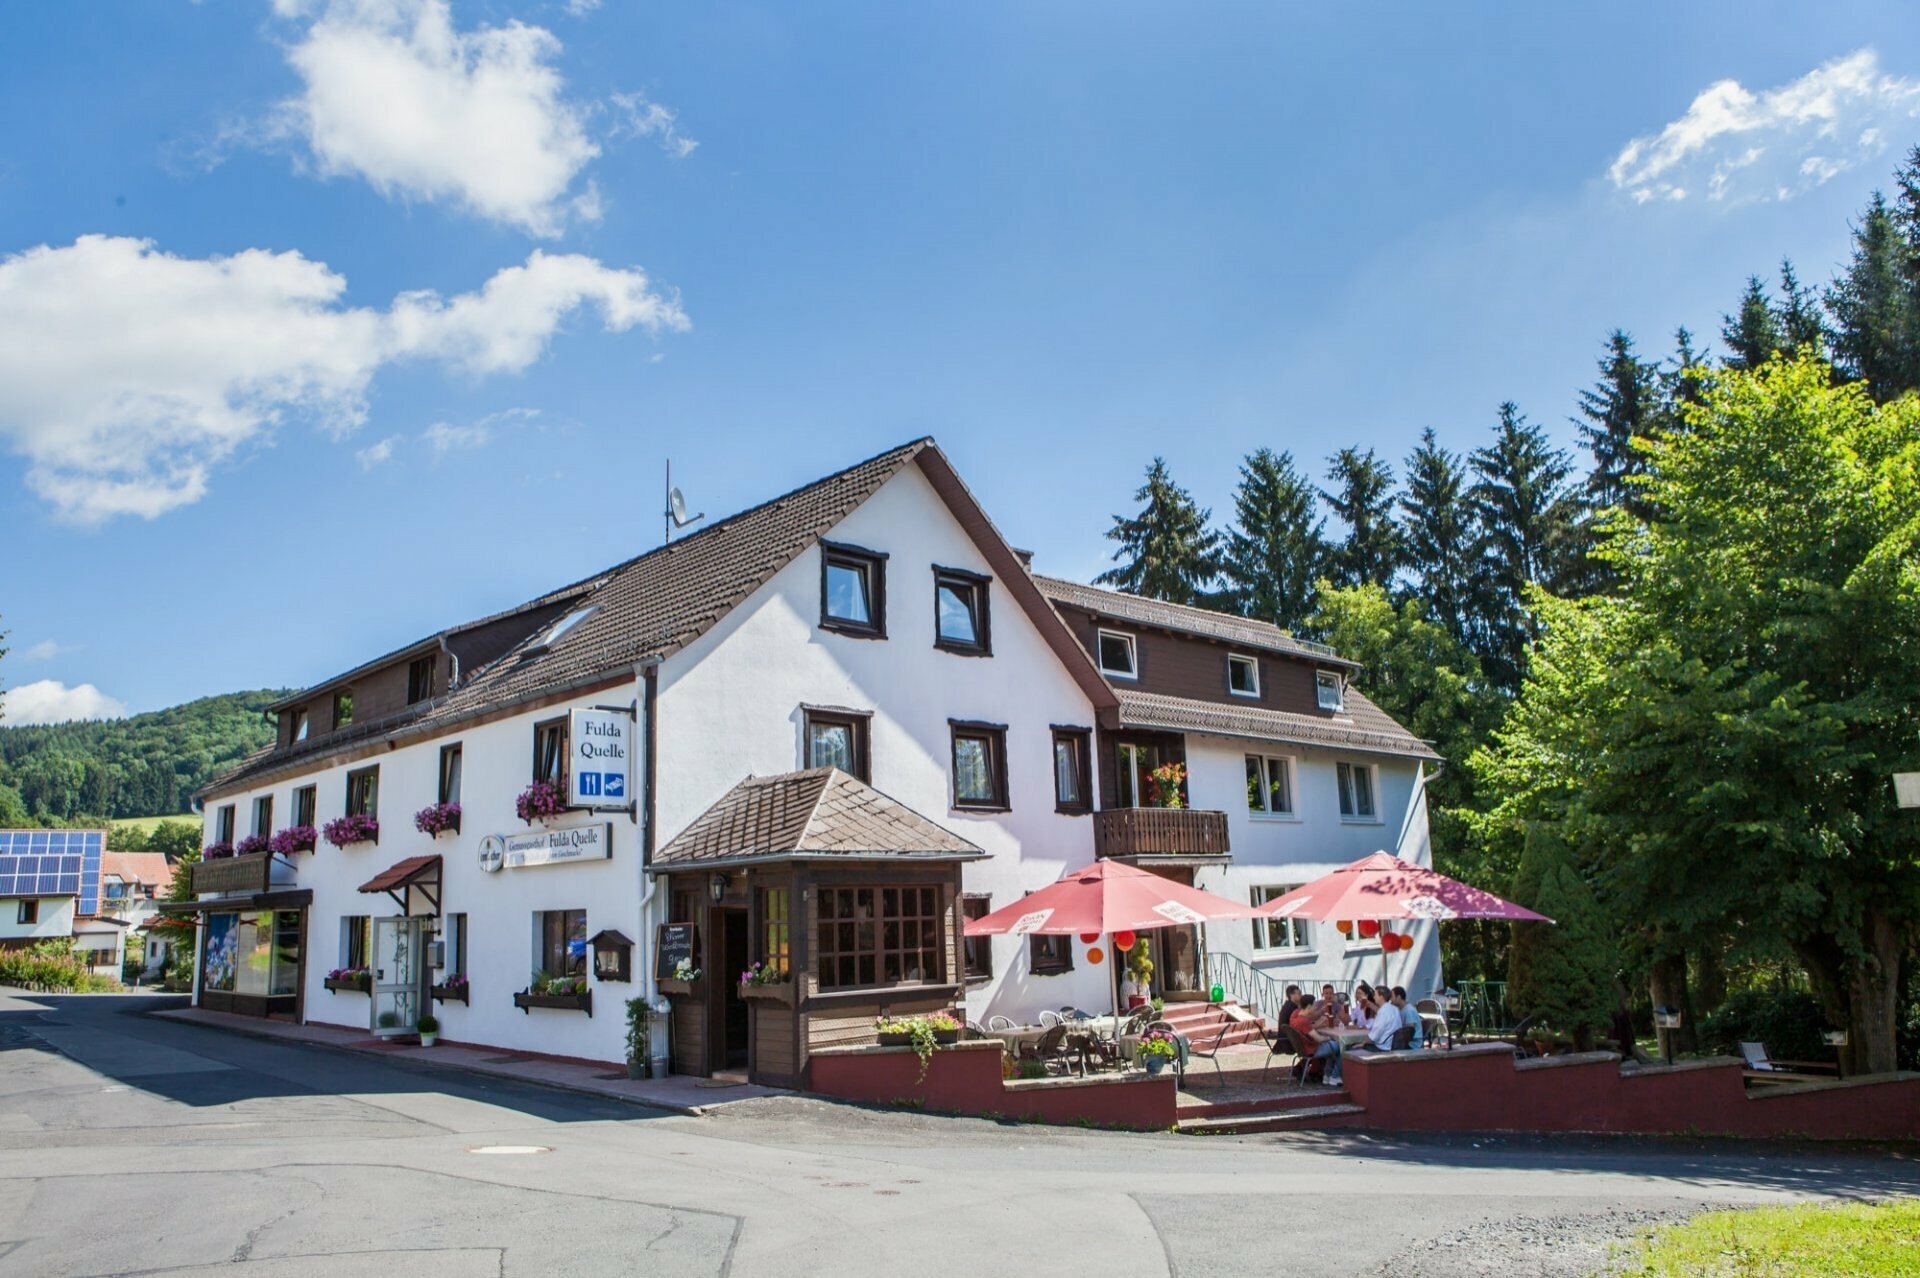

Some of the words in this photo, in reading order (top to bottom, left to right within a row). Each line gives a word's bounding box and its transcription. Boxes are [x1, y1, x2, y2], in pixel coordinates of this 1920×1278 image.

[585, 721, 621, 737] Fulda
[580, 742, 625, 759] Quelle
[549, 833, 570, 848] Fulda
[571, 829, 598, 847] Quelle
